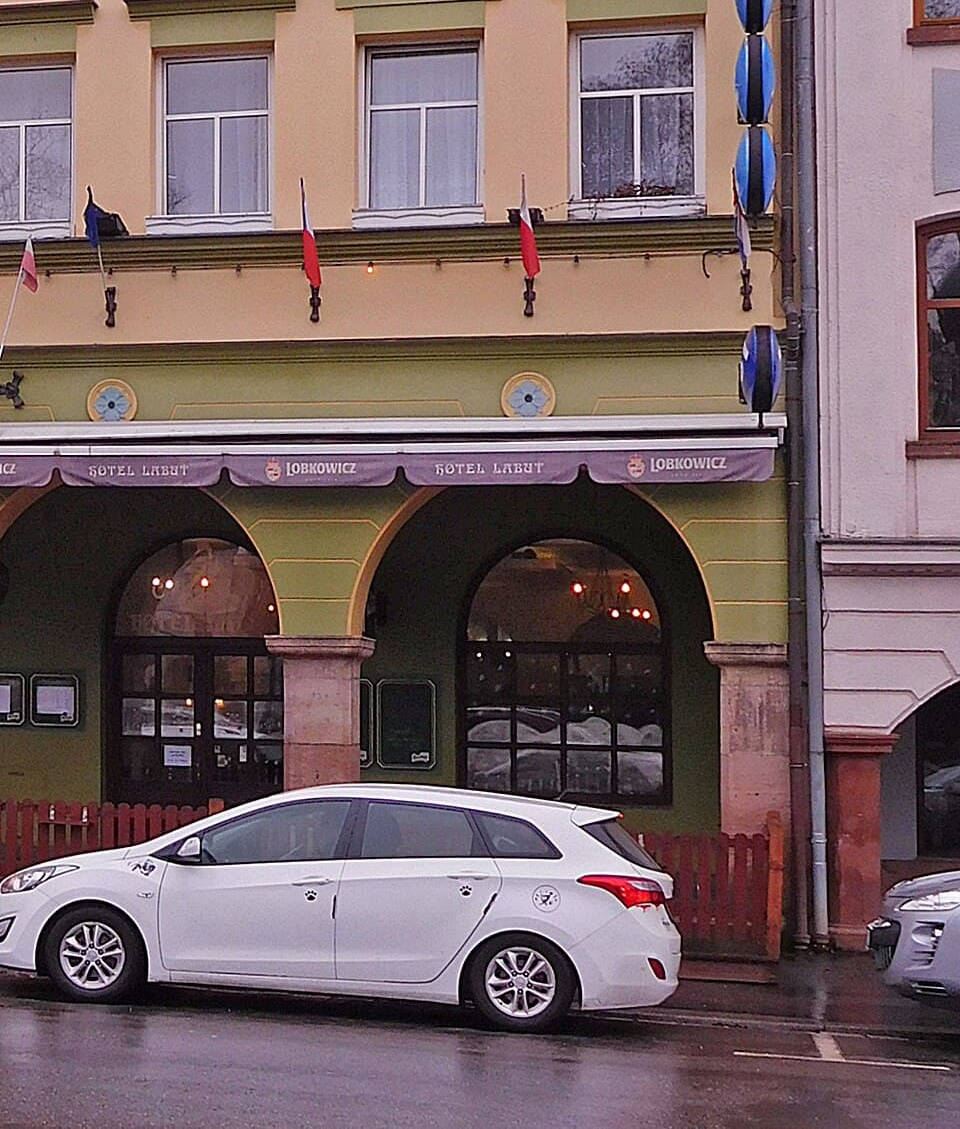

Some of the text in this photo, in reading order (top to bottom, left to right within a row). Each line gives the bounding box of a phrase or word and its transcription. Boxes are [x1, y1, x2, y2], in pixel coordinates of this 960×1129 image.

[88, 465, 135, 478] HOTEL
[286, 462, 357, 477] LOBKOWICZ
[435, 462, 485, 476] HOTEL
[650, 457, 728, 473] LOBKOWICZ
